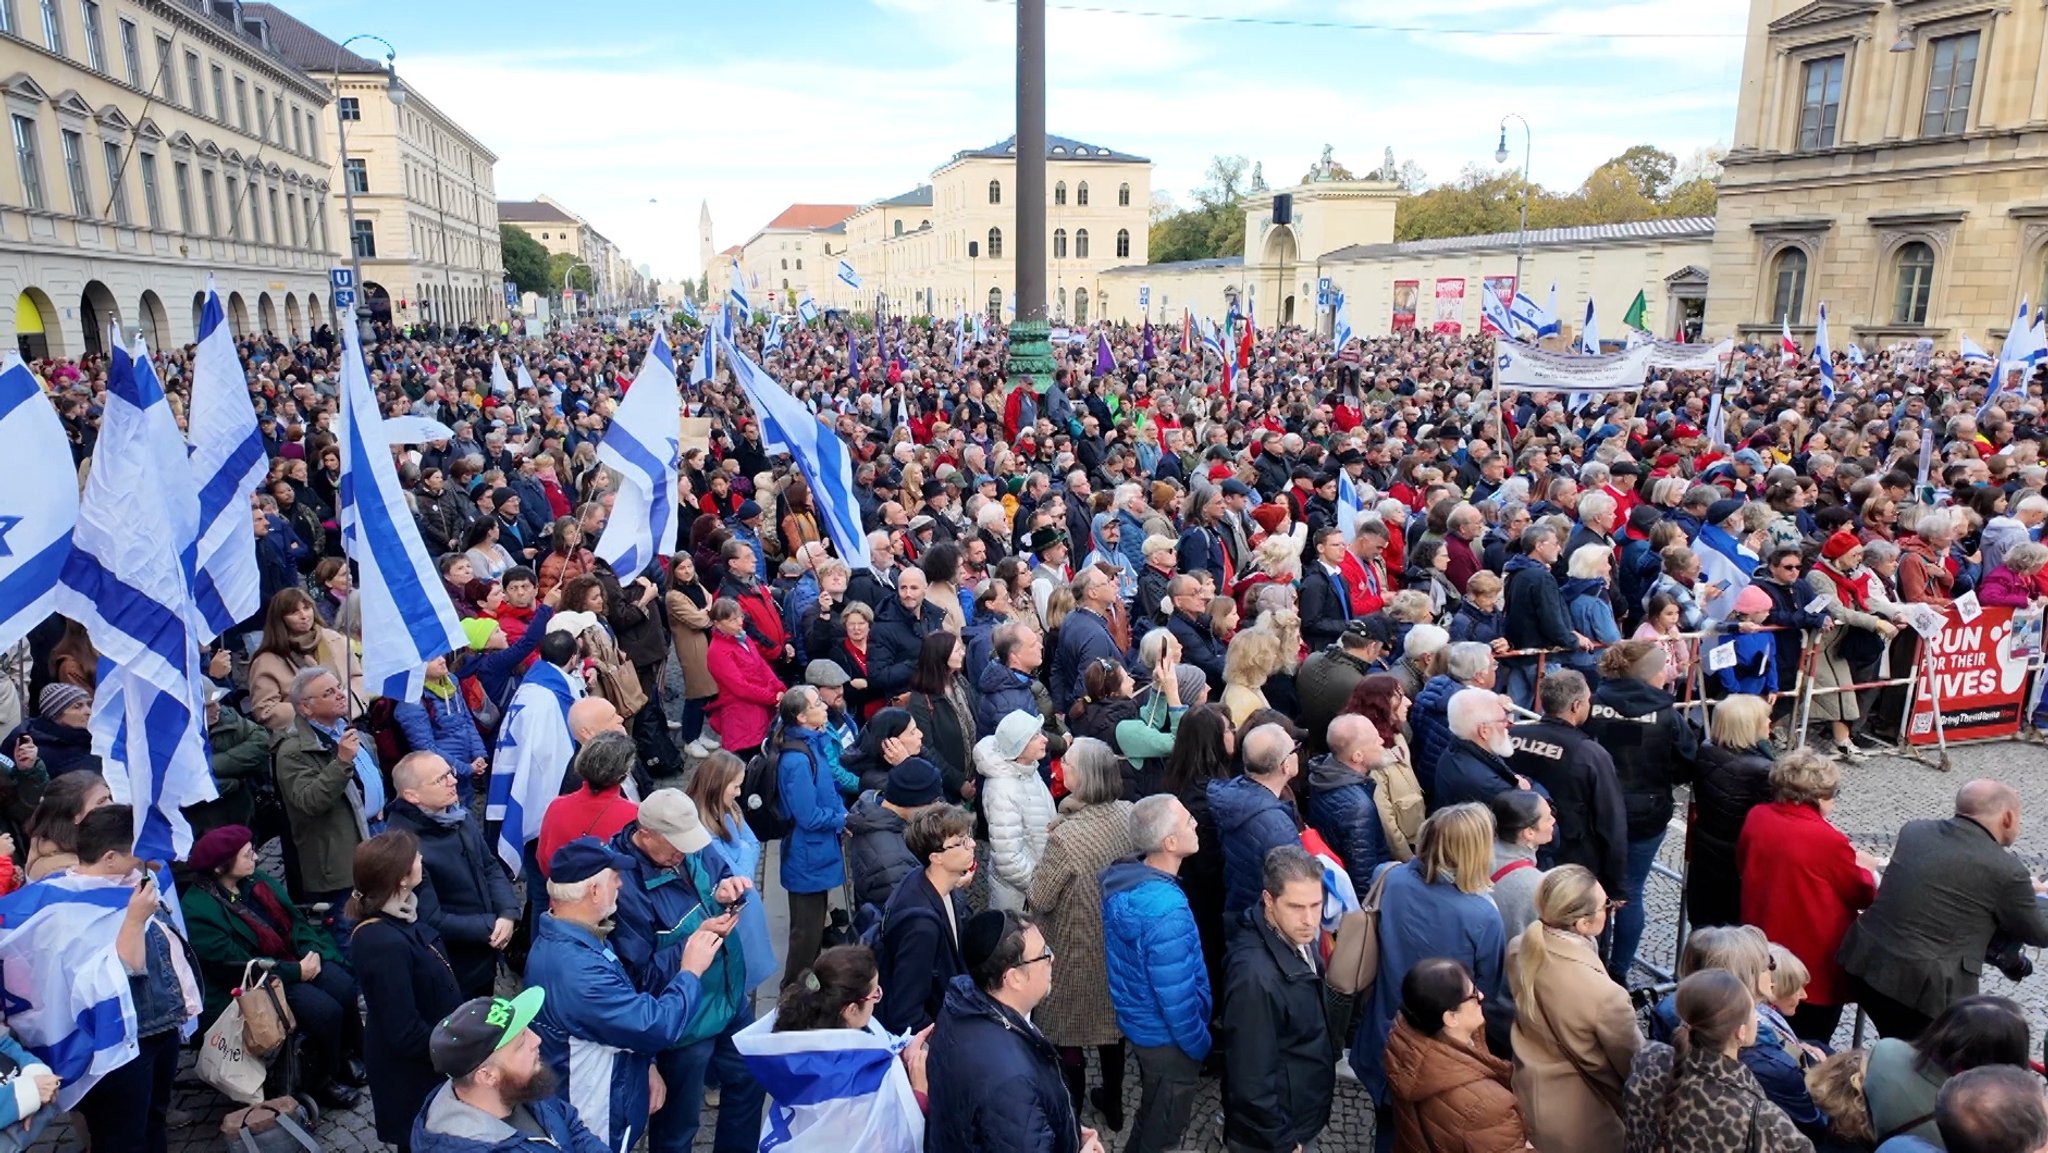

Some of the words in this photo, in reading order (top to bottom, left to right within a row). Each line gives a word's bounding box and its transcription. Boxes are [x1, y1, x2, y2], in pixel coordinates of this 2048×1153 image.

[336, 271, 349, 286] U
[1321, 280, 1329, 290] U
[1925, 626, 1983, 655] RUN
[1951, 653, 1986, 668] THEIR
[1918, 669, 1997, 701] LIVES
[1508, 735, 1564, 760] OLIZEI
